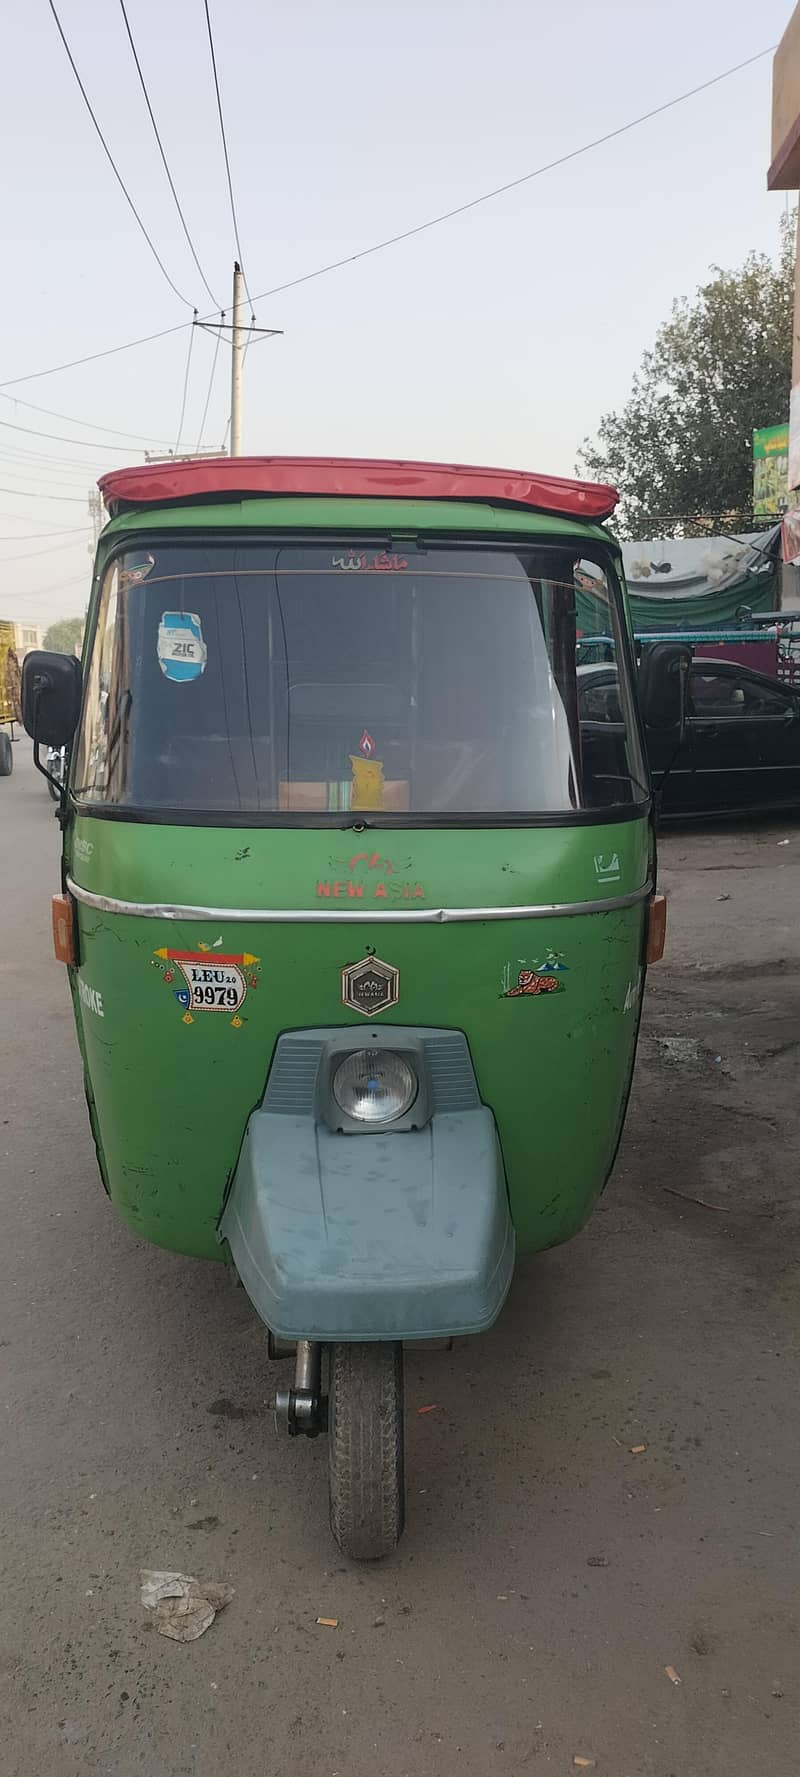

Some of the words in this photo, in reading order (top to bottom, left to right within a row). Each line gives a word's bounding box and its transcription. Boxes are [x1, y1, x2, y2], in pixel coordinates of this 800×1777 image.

[172, 642, 195, 655] ZIC
[317, 880, 363, 897] NEW
[375, 881, 424, 898] ASIA
[191, 968, 225, 983] LEU
[193, 985, 238, 1006] 9979
